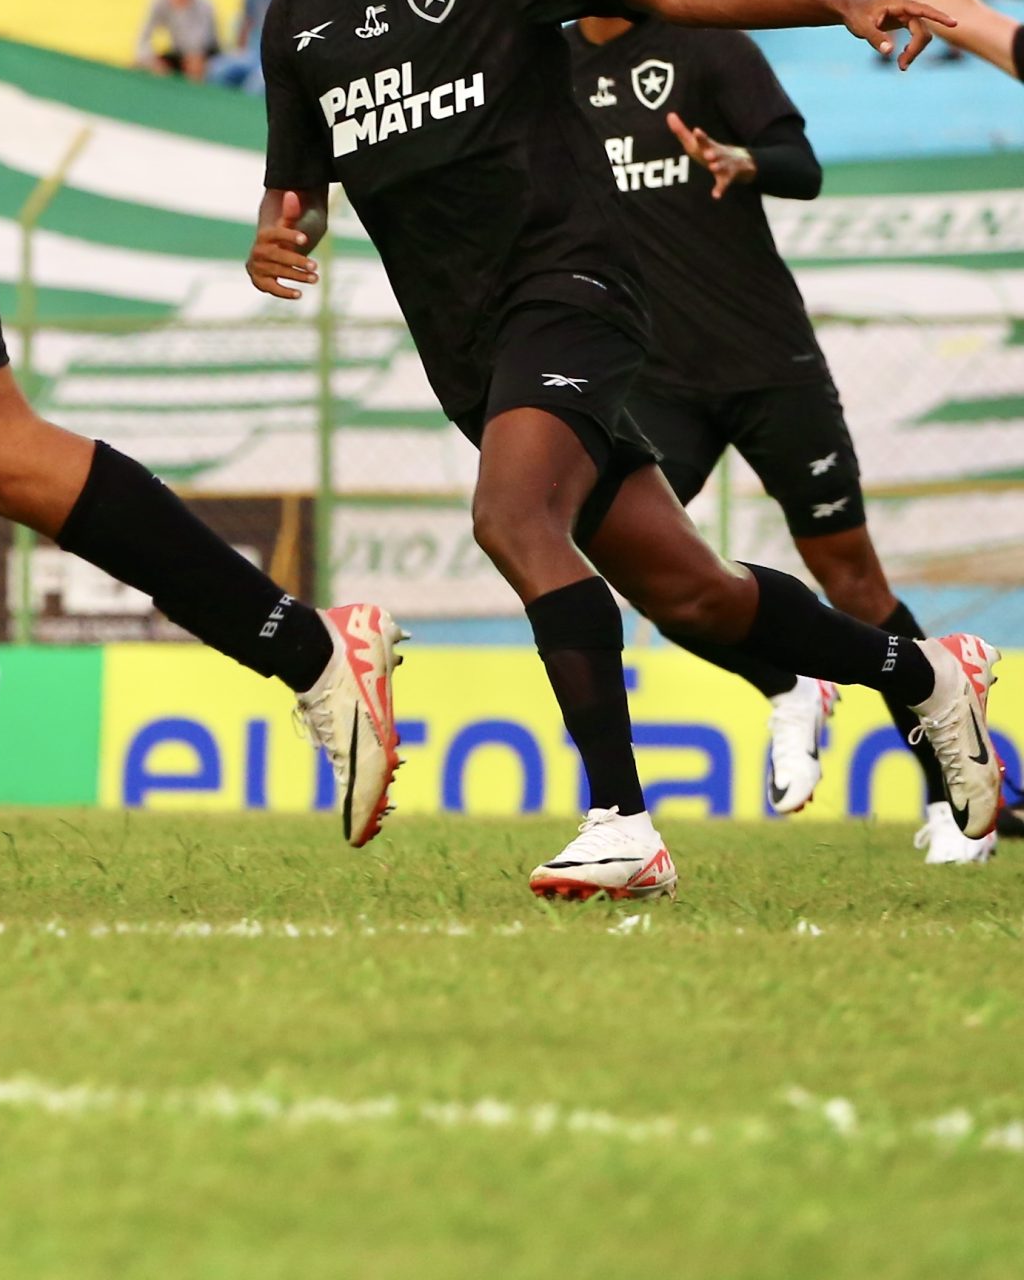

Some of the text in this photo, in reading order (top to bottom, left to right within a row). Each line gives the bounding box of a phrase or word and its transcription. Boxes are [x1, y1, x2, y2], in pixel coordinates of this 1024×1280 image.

[319, 61, 413, 128] PARI
[332, 72, 485, 158] MATCH
[258, 593, 296, 638] BFR
[881, 635, 899, 671] BFR
